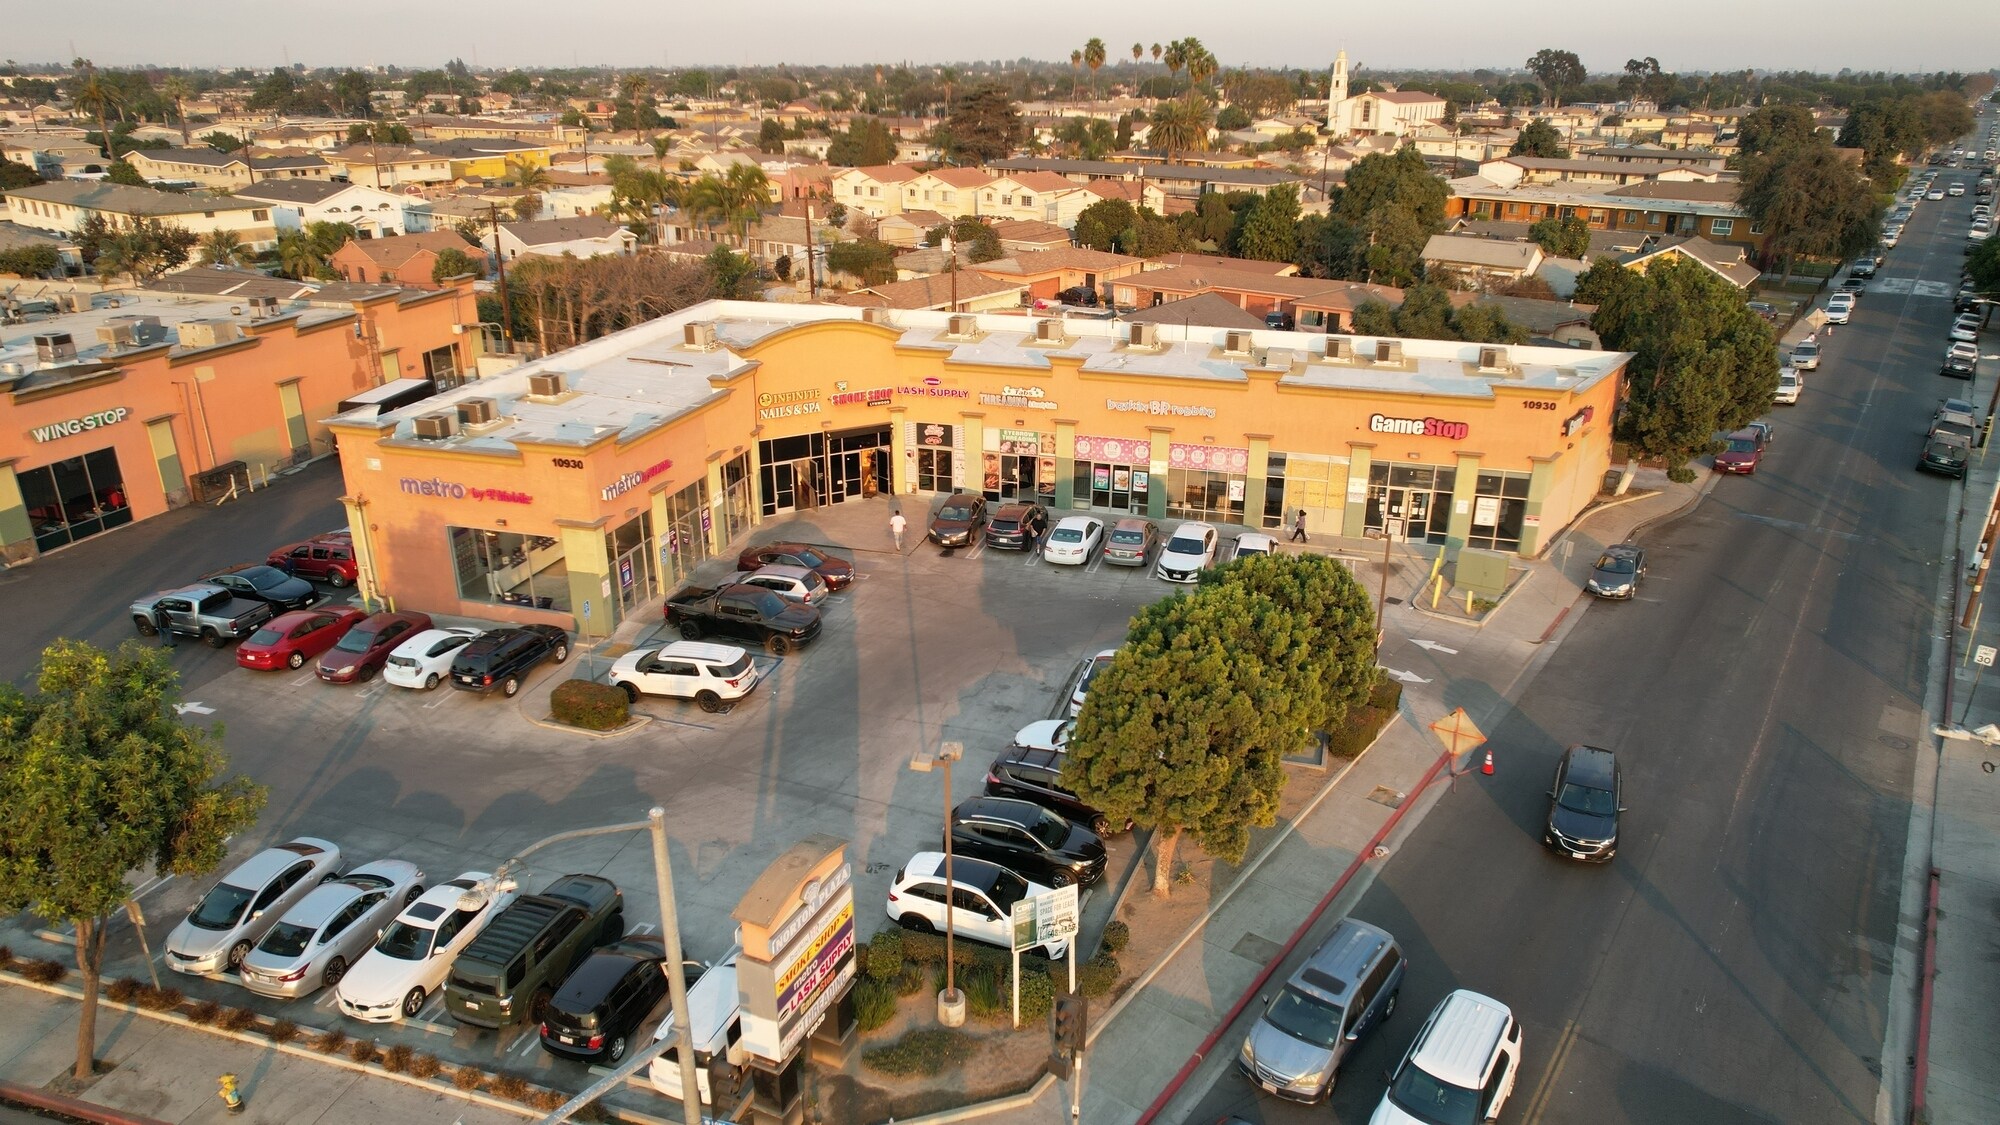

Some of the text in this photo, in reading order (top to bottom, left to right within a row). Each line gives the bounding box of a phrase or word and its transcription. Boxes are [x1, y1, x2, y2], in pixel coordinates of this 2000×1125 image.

[773, 389, 820, 404] INFINITE
[832, 388, 893, 406] SMOKE SHOP
[897, 386, 969, 398] LASH SUPPLY
[979, 393, 1028, 408] THREADING
[760, 402, 820, 419] NAILS & SPA
[1149, 400, 1170, 415] BR
[1523, 400, 1557, 411] 10930
[1371, 413, 1469, 440] GameStop
[1002, 434, 1037, 443] THREADING
[552, 458, 584, 470] 10930
[400, 477, 466, 500] metro
[471, 487, 484, 502] by
[602, 471, 643, 501] metro
[1977, 655, 1991, 664] 30
[775, 902, 816, 950] NORTON
[818, 868, 848, 906] PLAZA
[1040, 899, 1075, 916] SPACE FOR LEASE
[779, 948, 812, 992] SMOKE
[815, 918, 840, 952] SHOP
[791, 974, 817, 1011] LASH
[819, 931, 854, 978] SUPPLY
[793, 959, 818, 991] metro
[800, 969, 836, 1016] GameStop
[802, 970, 848, 1029] THREADING
[806, 1012, 826, 1039] 10930
